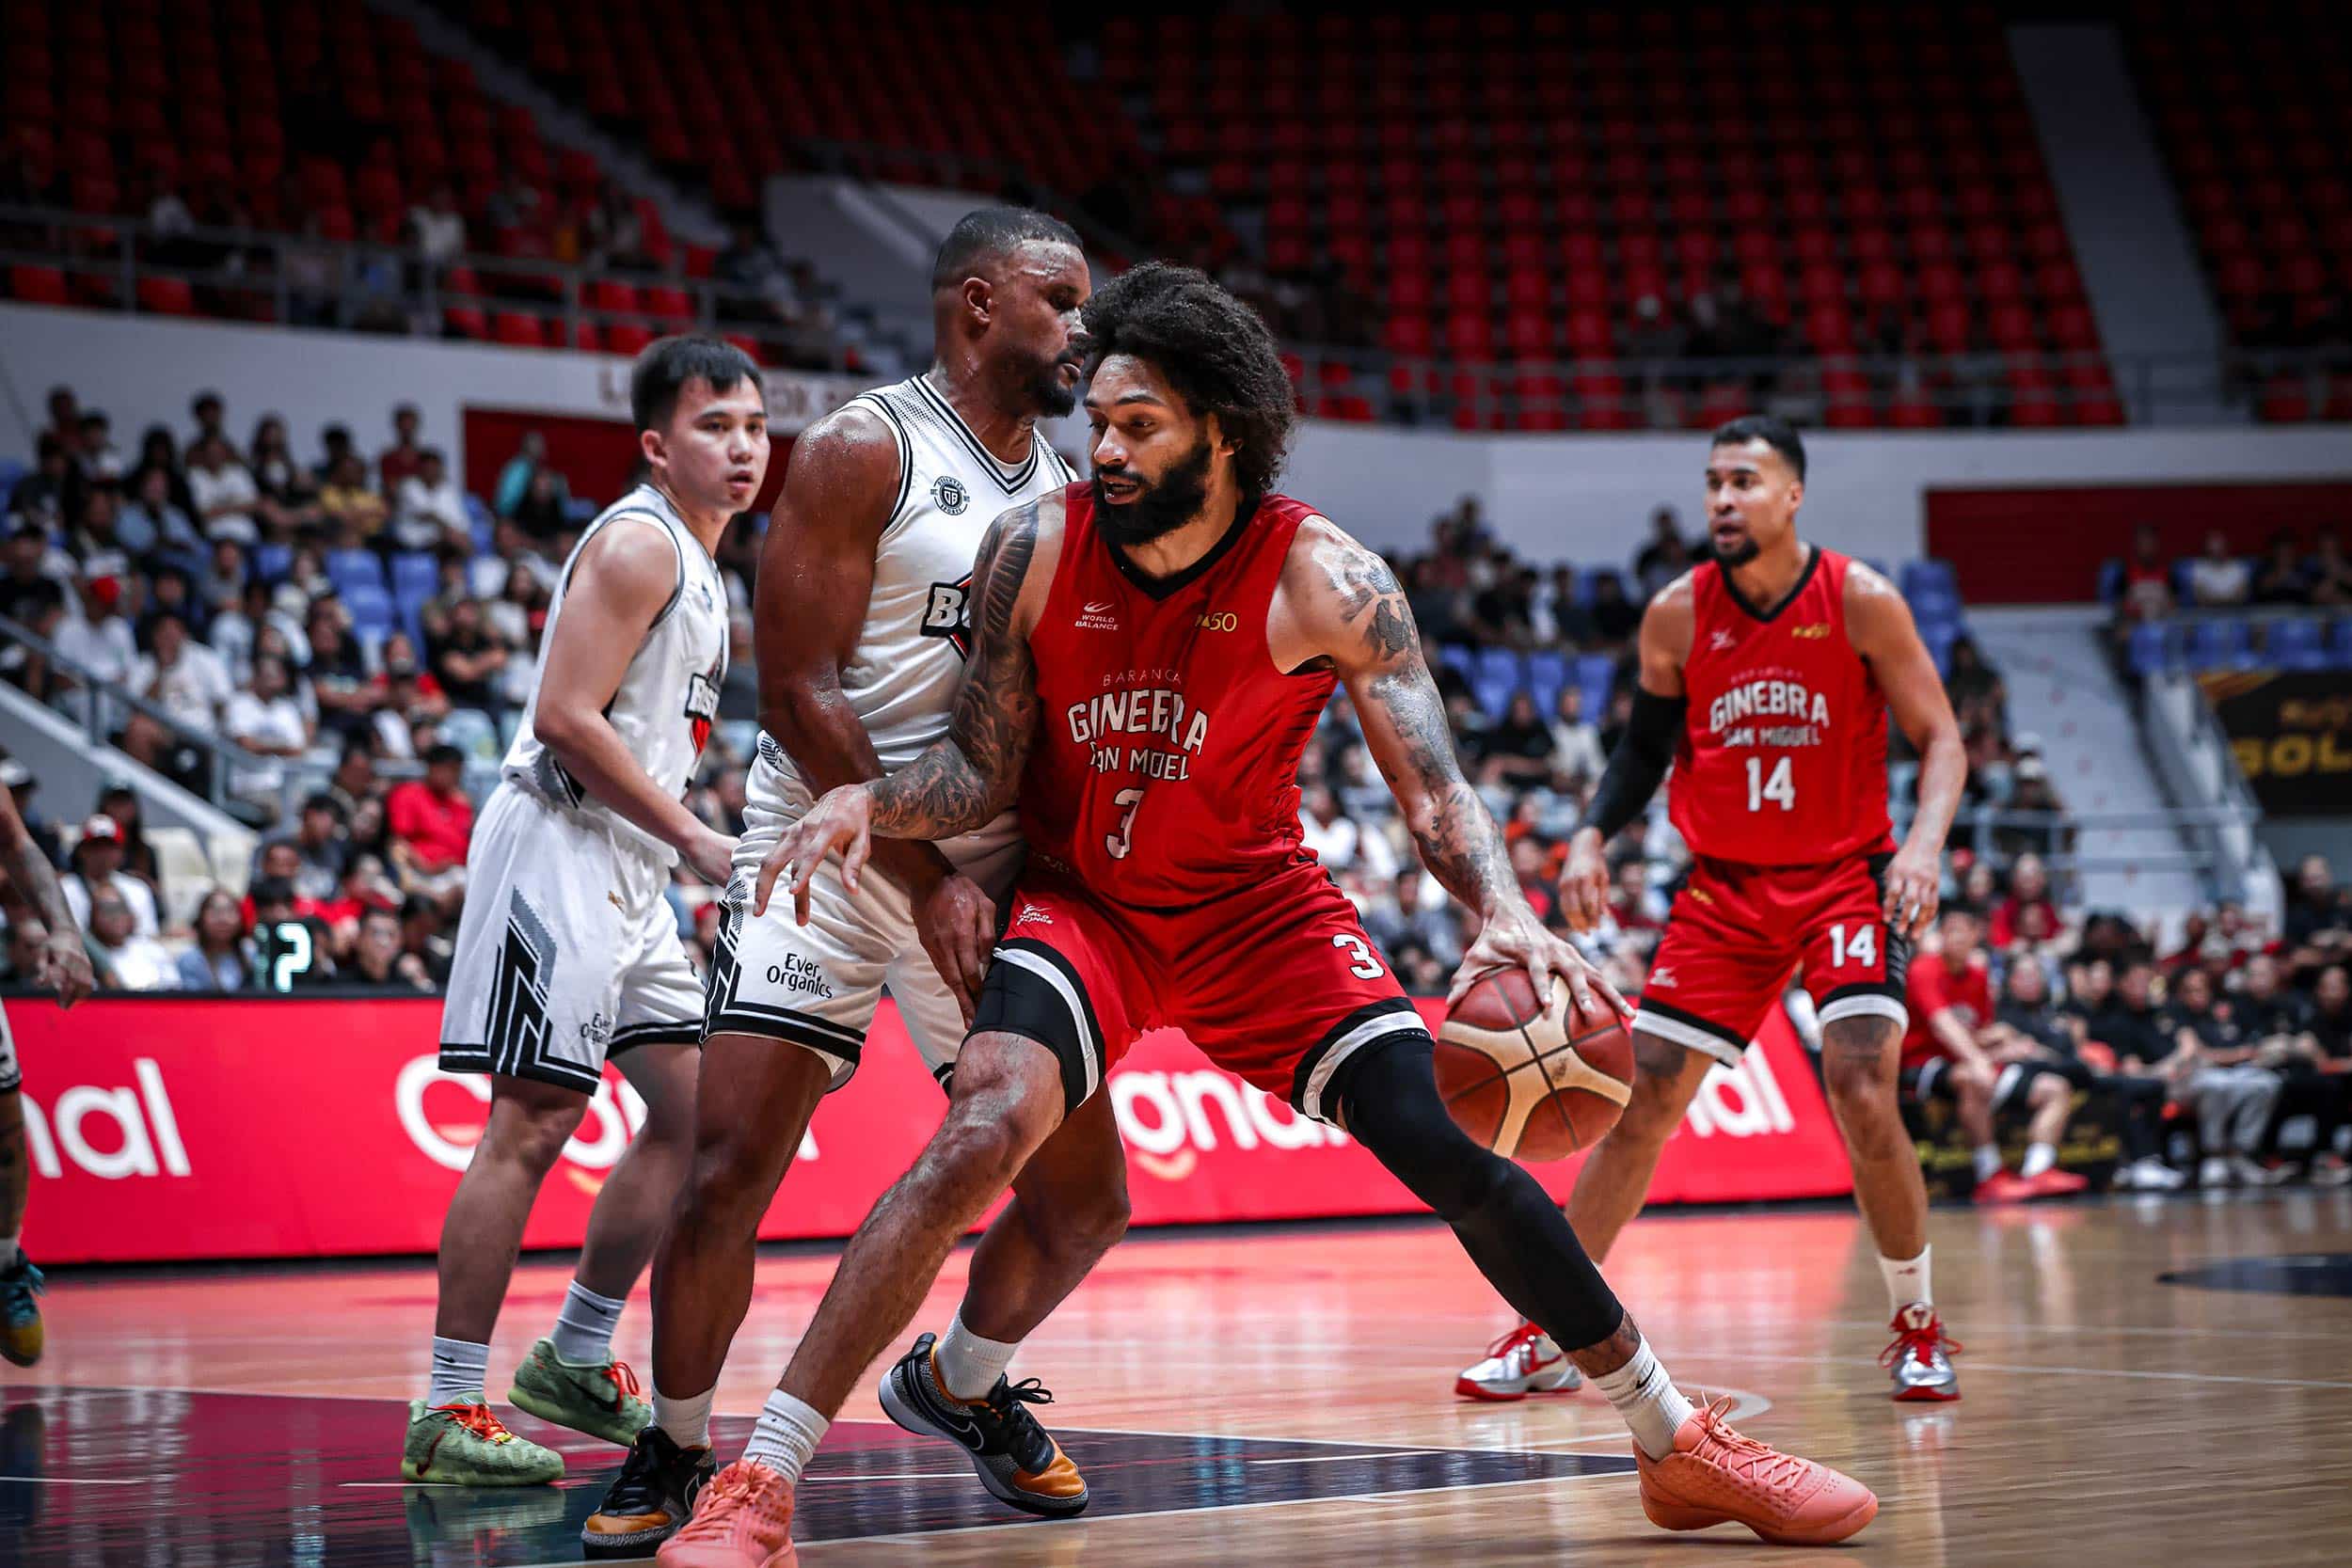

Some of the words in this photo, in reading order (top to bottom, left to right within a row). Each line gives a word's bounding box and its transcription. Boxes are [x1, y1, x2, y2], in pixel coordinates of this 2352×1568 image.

[1708, 680, 1831, 735] GINEBRA
[1745, 755, 1796, 812] 14
[1106, 788, 1145, 859] 3
[785, 952, 820, 977] Ever
[1332, 933, 1386, 980] 3
[1828, 923, 1877, 968] 14
[767, 965, 833, 998] Organics
